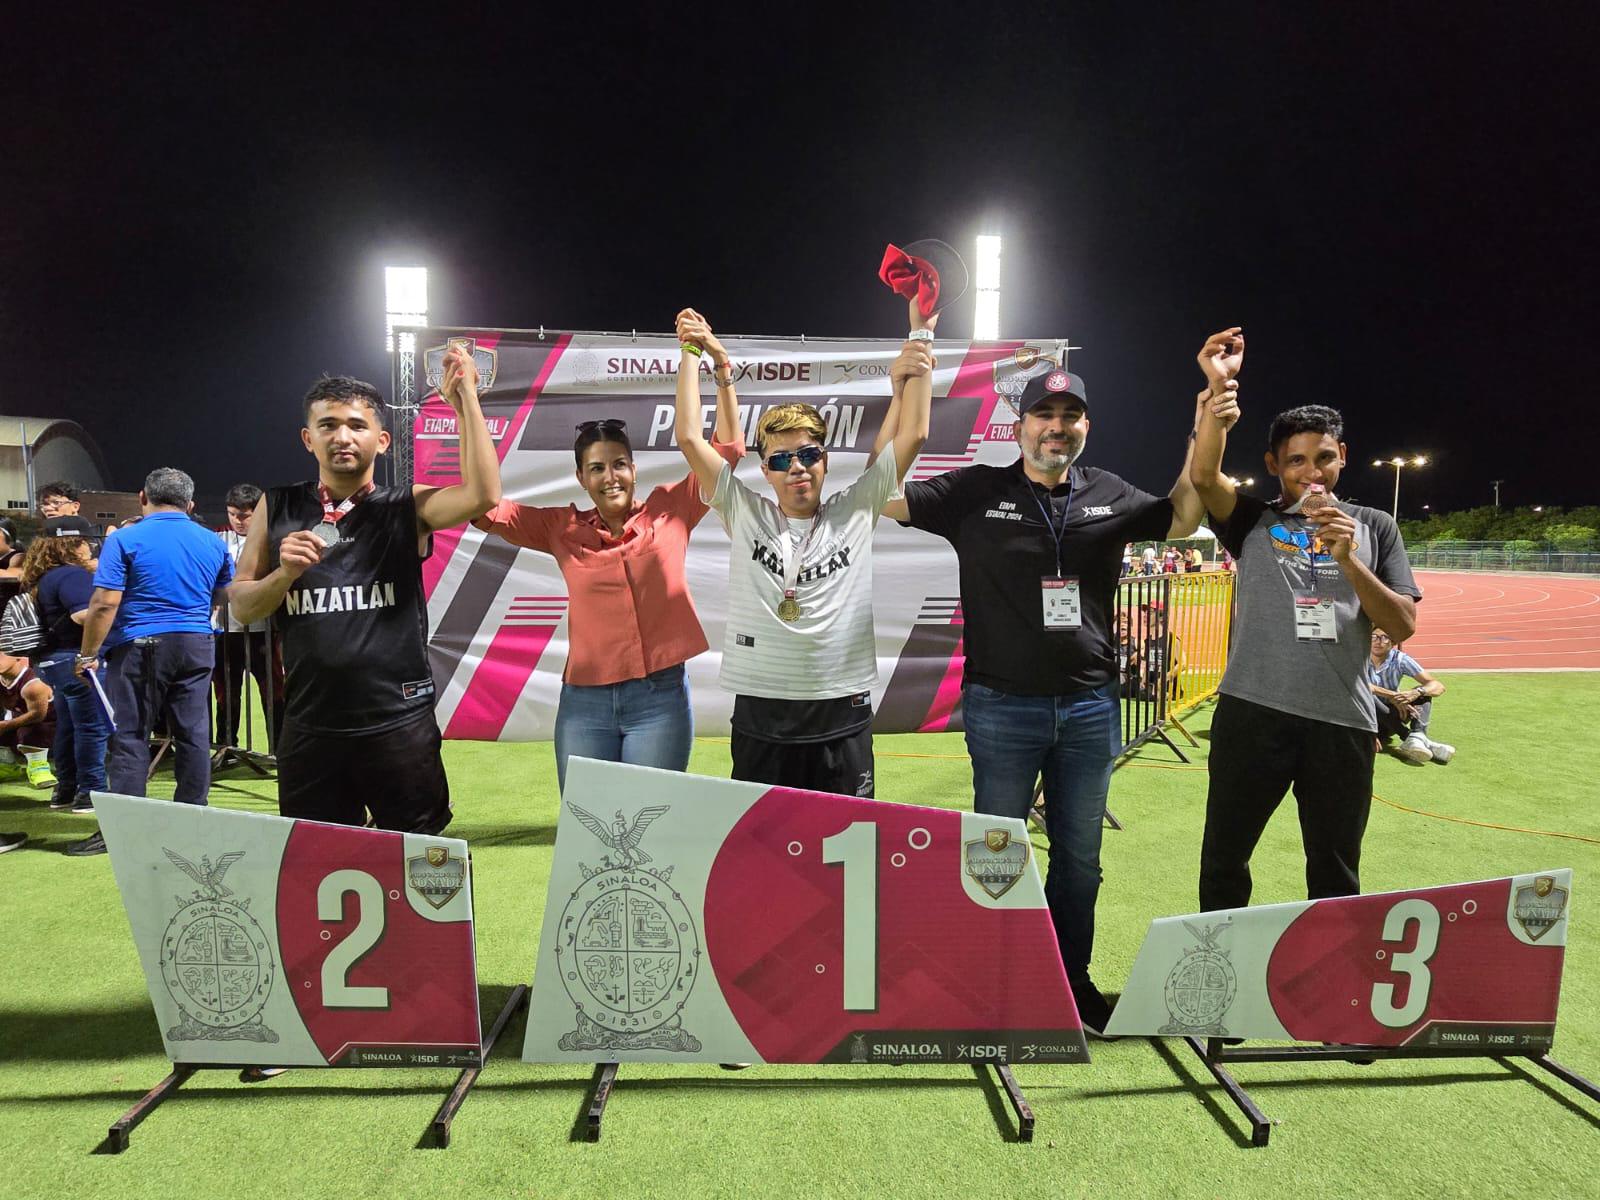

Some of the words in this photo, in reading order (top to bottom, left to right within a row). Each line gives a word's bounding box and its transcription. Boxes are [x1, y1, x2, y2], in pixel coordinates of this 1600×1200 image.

[607, 358, 712, 374] SINALA
[757, 362, 811, 381] ISDE
[423, 418, 456, 433] ETAPA
[1090, 505, 1113, 516] ISDE
[285, 581, 396, 616] MAZATLÁN
[596, 875, 657, 892] SINALOA
[190, 906, 239, 918] SINALOA
[823, 822, 876, 1010] 1
[317, 869, 388, 1008] 2
[1371, 898, 1441, 1028] 3
[611, 1016, 648, 1026] 1831
[1442, 1033, 1480, 1041] SINALOA
[1495, 1035, 1515, 1044] ISDE
[872, 1043, 942, 1056] SINALOA
[970, 1045, 1007, 1058] ISDE
[1039, 1045, 1080, 1053] CONADE
[362, 1053, 402, 1061] SINALOA
[418, 1055, 440, 1063] ISDE
